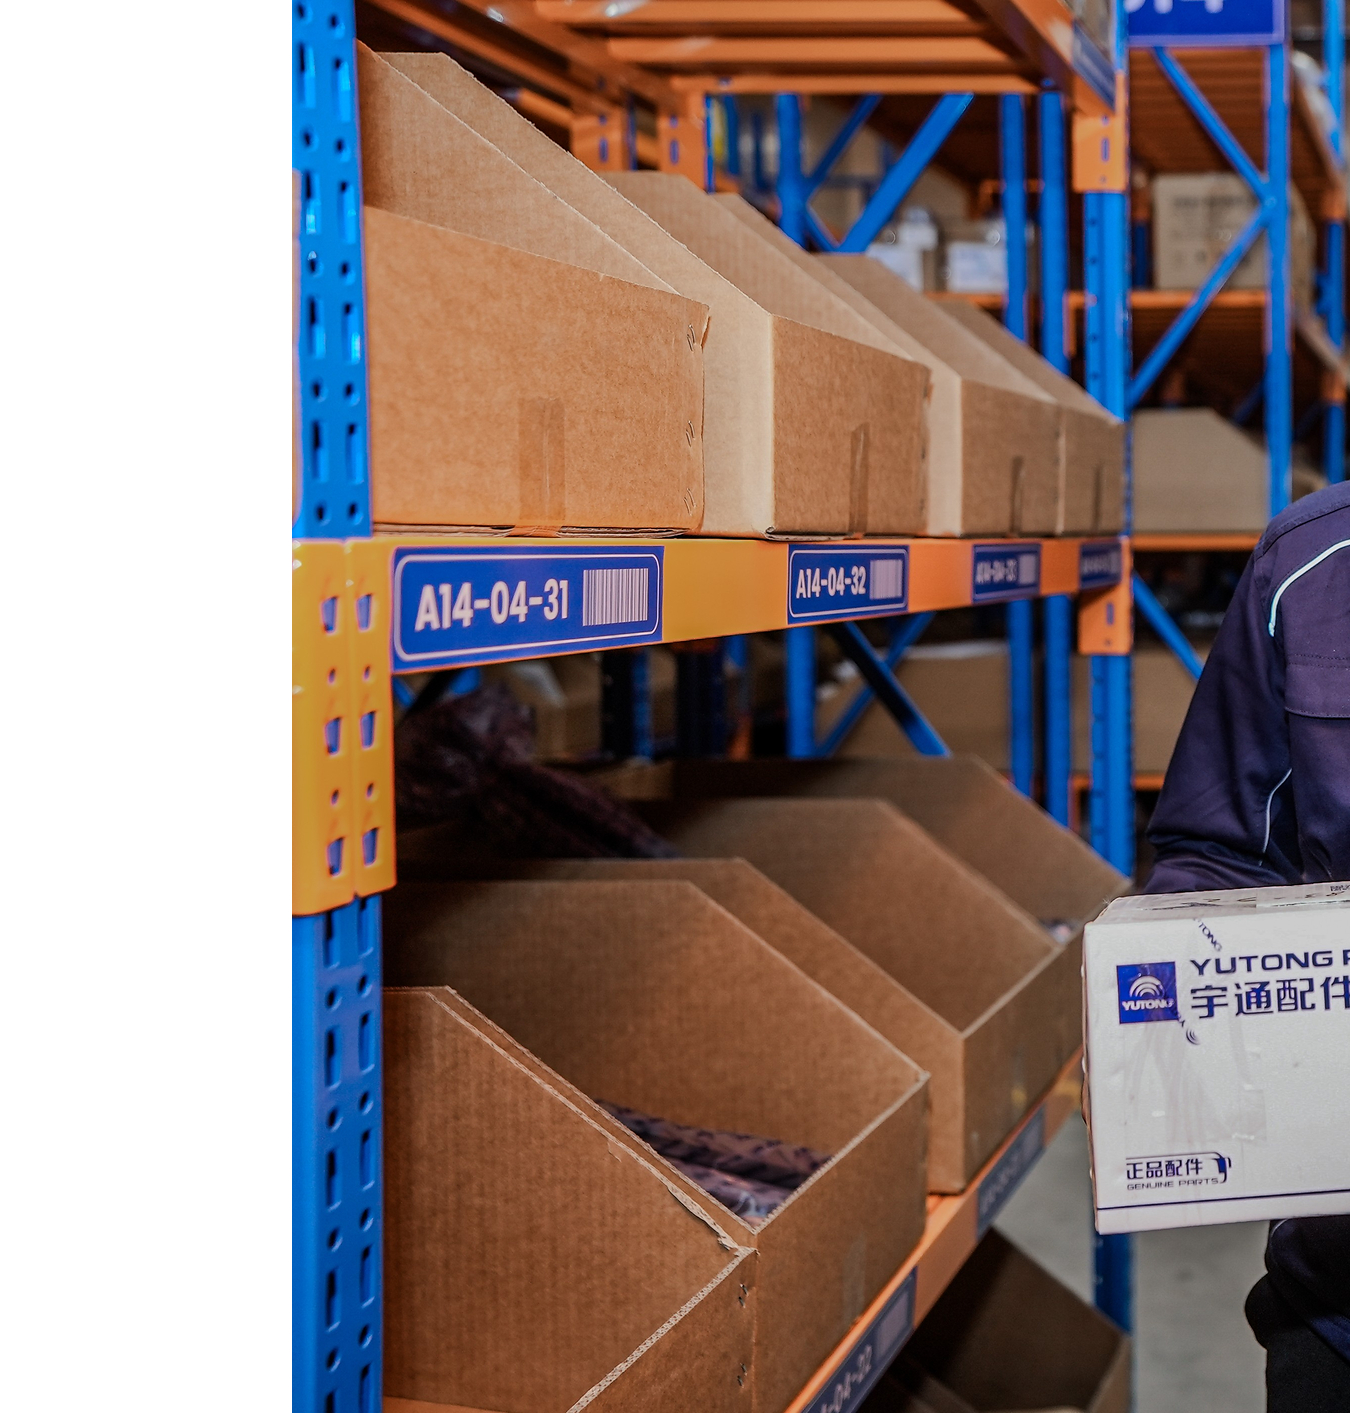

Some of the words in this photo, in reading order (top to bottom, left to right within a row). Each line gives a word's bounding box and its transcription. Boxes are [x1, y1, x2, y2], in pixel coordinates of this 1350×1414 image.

[796, 565, 867, 599] A14-04-32
[414, 578, 569, 632] A14-04-31
[1190, 950, 1333, 976] YUTONG
[1126, 1158, 1203, 1180] 正品配件
[1127, 1181, 1174, 1191] GENUINE
[1178, 1177, 1219, 1187] PARTS
